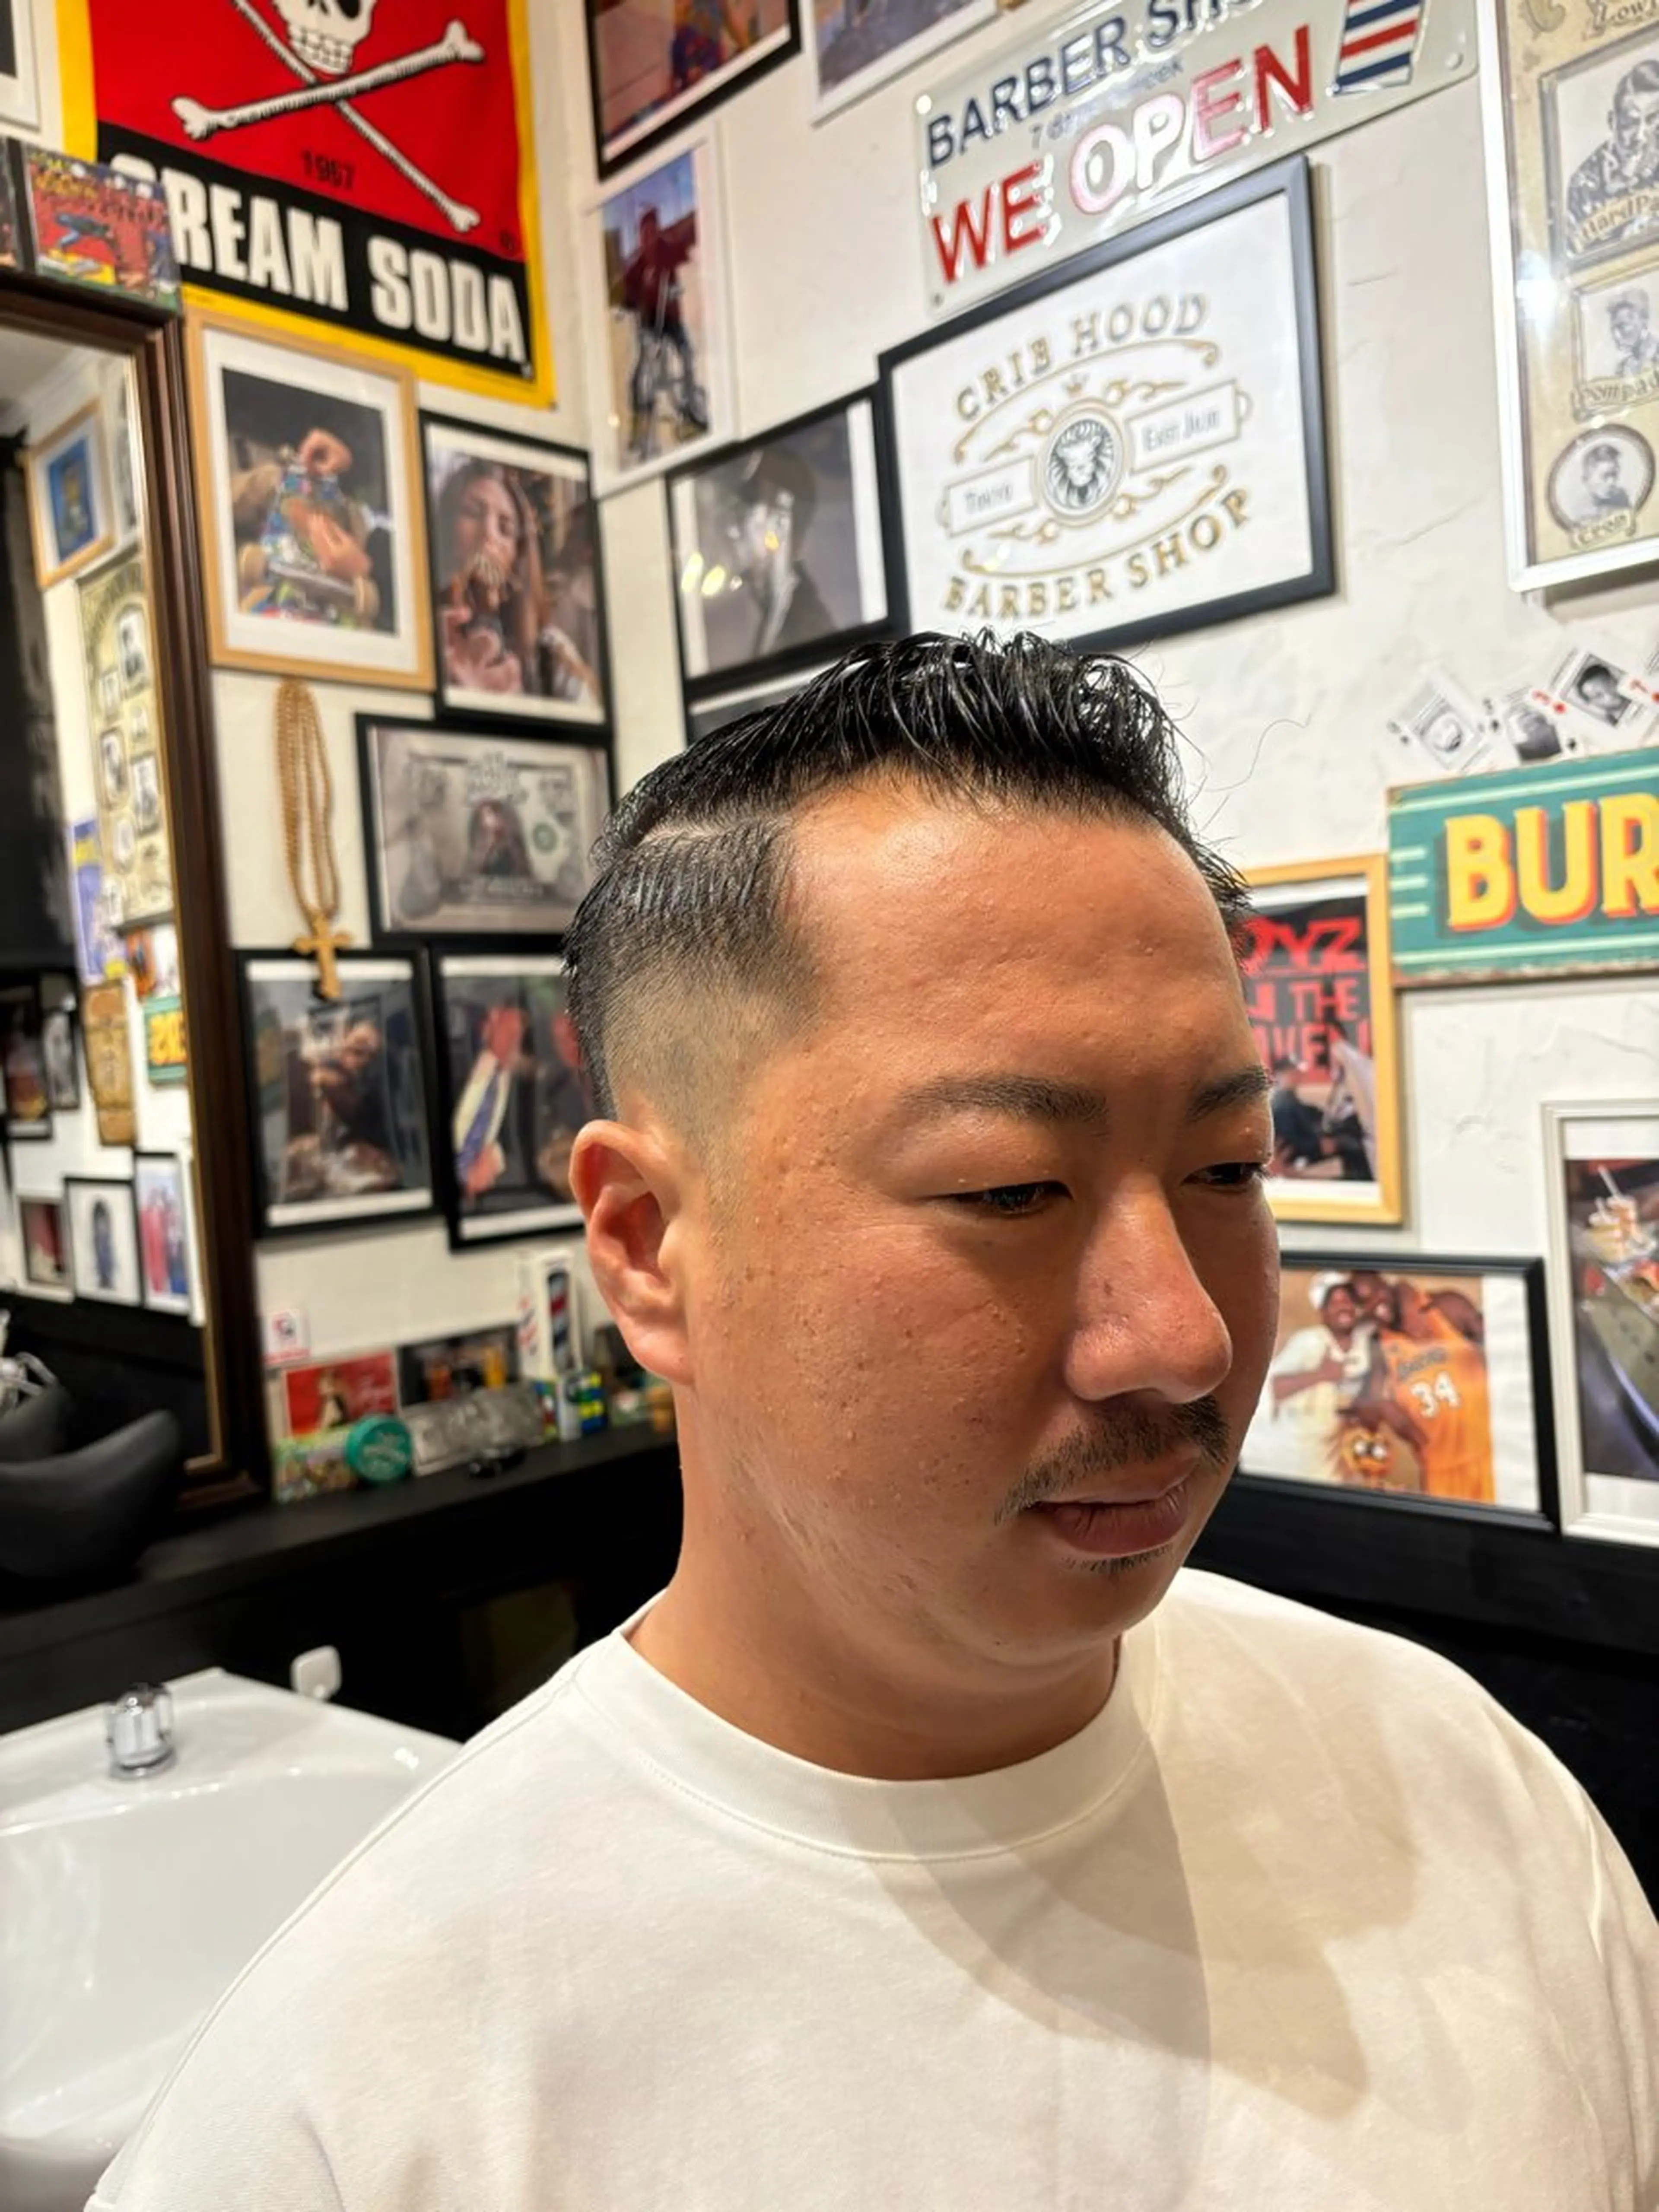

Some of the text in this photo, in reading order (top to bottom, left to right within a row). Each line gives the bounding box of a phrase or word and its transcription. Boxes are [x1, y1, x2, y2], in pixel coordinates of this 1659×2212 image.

[928, 16, 1129, 168] BARBER
[932, 23, 1312, 283] WE OPEN
[110, 153, 527, 361] REAM SODA
[957, 295, 1208, 421] CRIB HOOD
[944, 488, 1250, 620] BARBER SHOP
[1444, 792, 1659, 932] BUR
[1290, 978, 1358, 1022] THE
[1410, 1370, 1461, 1419] 34
